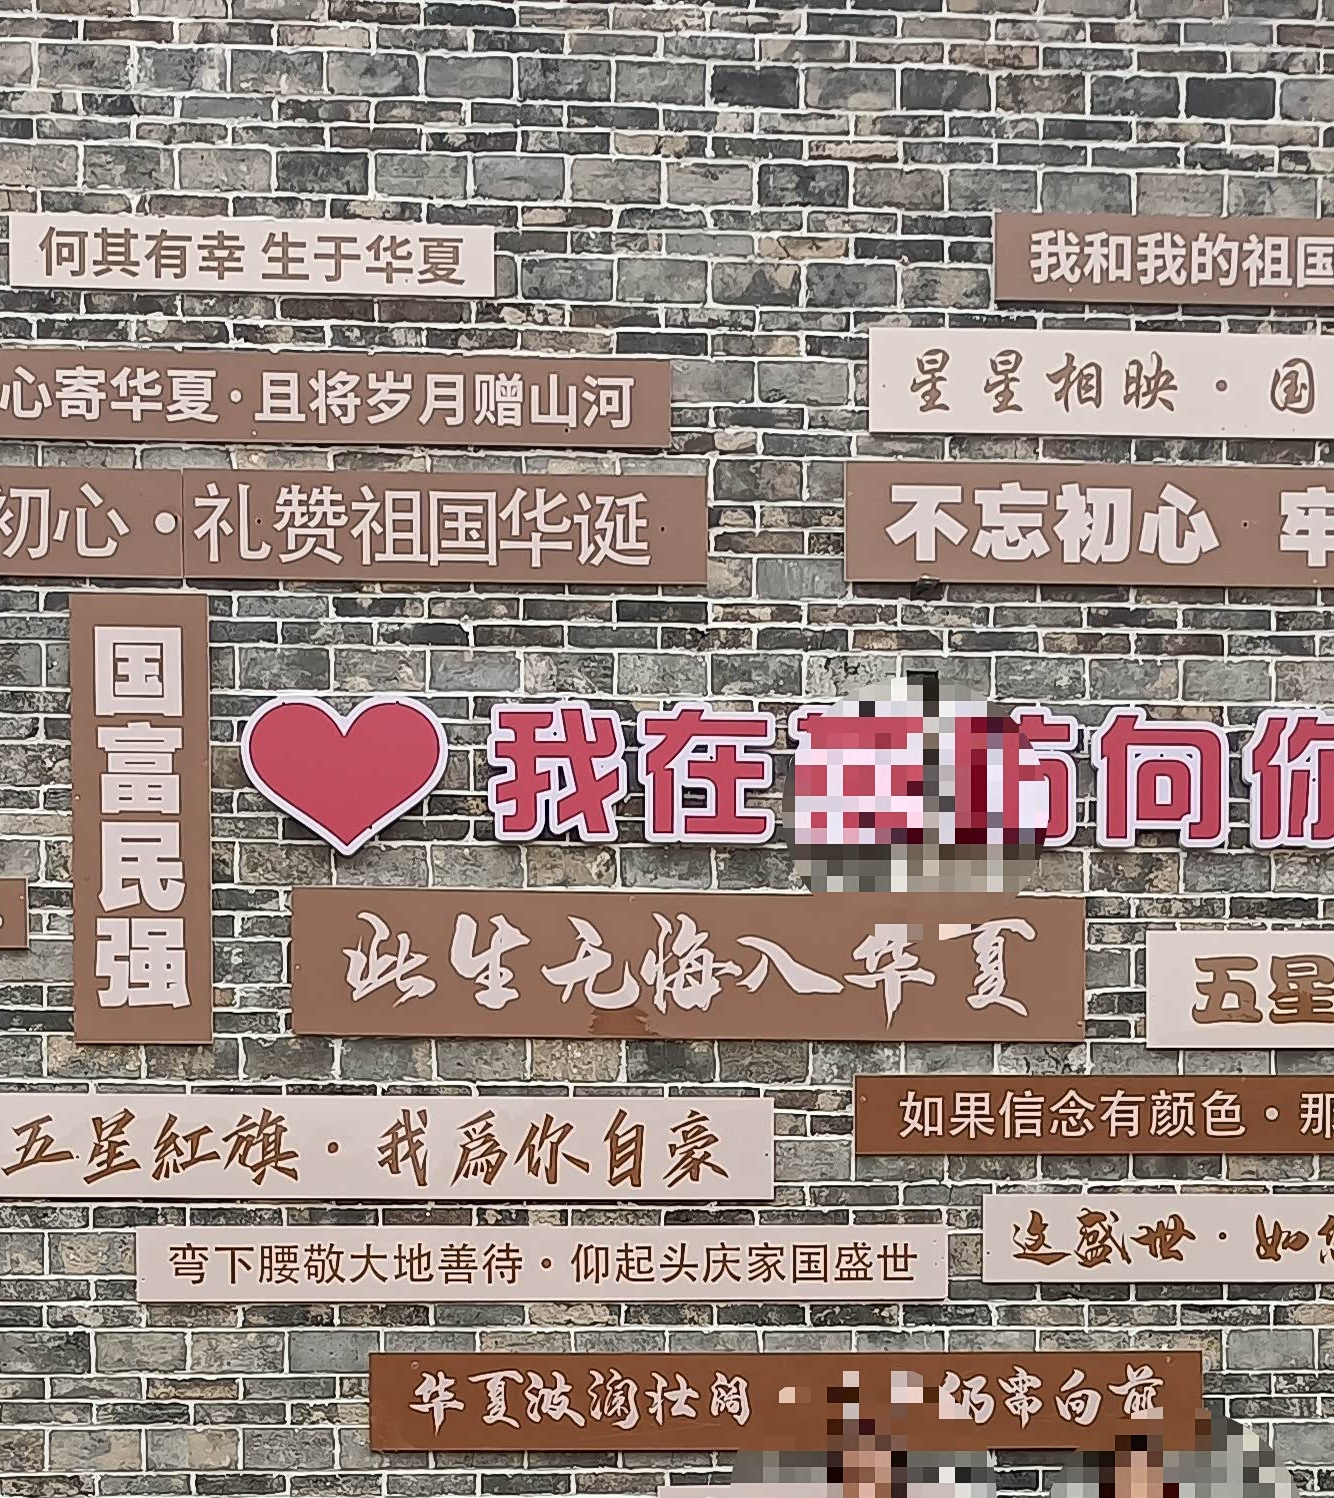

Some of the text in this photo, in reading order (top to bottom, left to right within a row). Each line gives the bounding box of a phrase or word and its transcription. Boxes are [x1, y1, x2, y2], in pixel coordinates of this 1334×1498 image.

[38, 227, 468, 285] 何其有幸 生于华夏
[888, 483, 1220, 564] 不忘初心
[93, 626, 191, 1009] 国富民强
[343, 912, 1037, 1030] 此生无悔入华夏
[168, 1242, 918, 1285] 弯下腰敬大地善待·仰起头庆家国盛世
